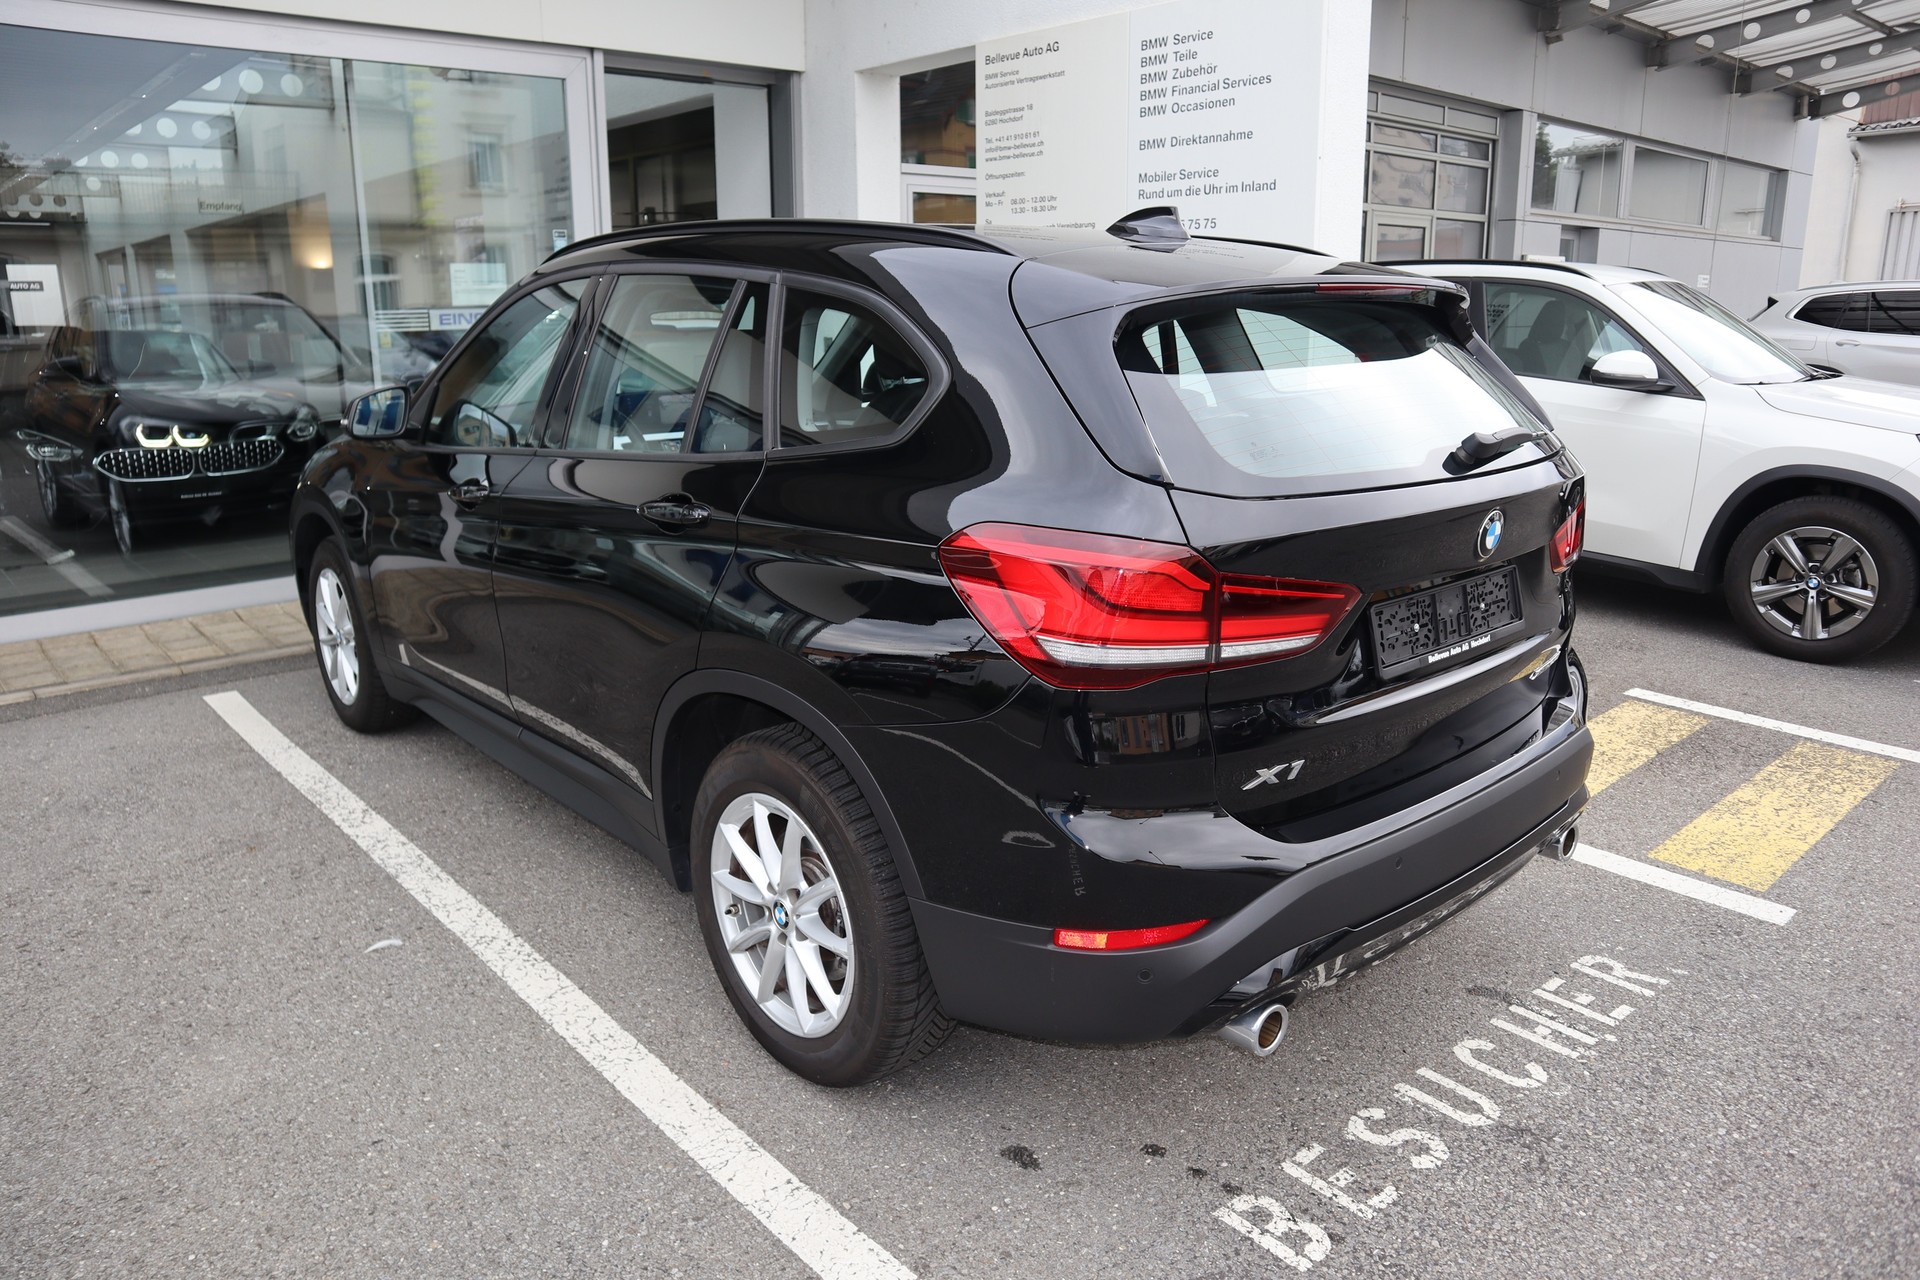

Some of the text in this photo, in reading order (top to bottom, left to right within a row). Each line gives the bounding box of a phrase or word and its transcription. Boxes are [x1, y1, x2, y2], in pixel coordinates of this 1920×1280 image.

[1141, 30, 1214, 51] BMW Service
[985, 41, 1060, 65] Bellevue Auto AG
[1140, 49, 1198, 68] BMW Teile
[985, 69, 1019, 80] BMW Service
[985, 70, 1065, 90] Autorisierte Vertragswerkstatt
[1140, 63, 1217, 84] BMW Zubehör
[1140, 74, 1272, 101] BMW Financial Services
[985, 106, 1025, 117] Baldeggstrasse
[1139, 97, 1235, 118] BMW Occasionen
[999, 115, 1023, 124] Hochdorf
[1139, 130, 1253, 150] BMW Direktannahme
[985, 149, 1043, 162] www.bmw-bellevue.ch
[985, 171, 1025, 181] Öffnungszeiten:
[1139, 167, 1219, 183] Mobiler Service
[1139, 179, 1277, 200] Rund um die Uhr im Inland
[199, 200, 242, 212] Empfang
[1031, 196, 1046, 204] 12.00
[1188, 218, 1201, 230] 75
[1203, 217, 1217, 229] 75
[1428, 634, 1490, 663] Bellevue Auto AG Hochdorf
[1240, 759, 1306, 790] X1
[1211, 952, 1670, 1273] BESUCHER
